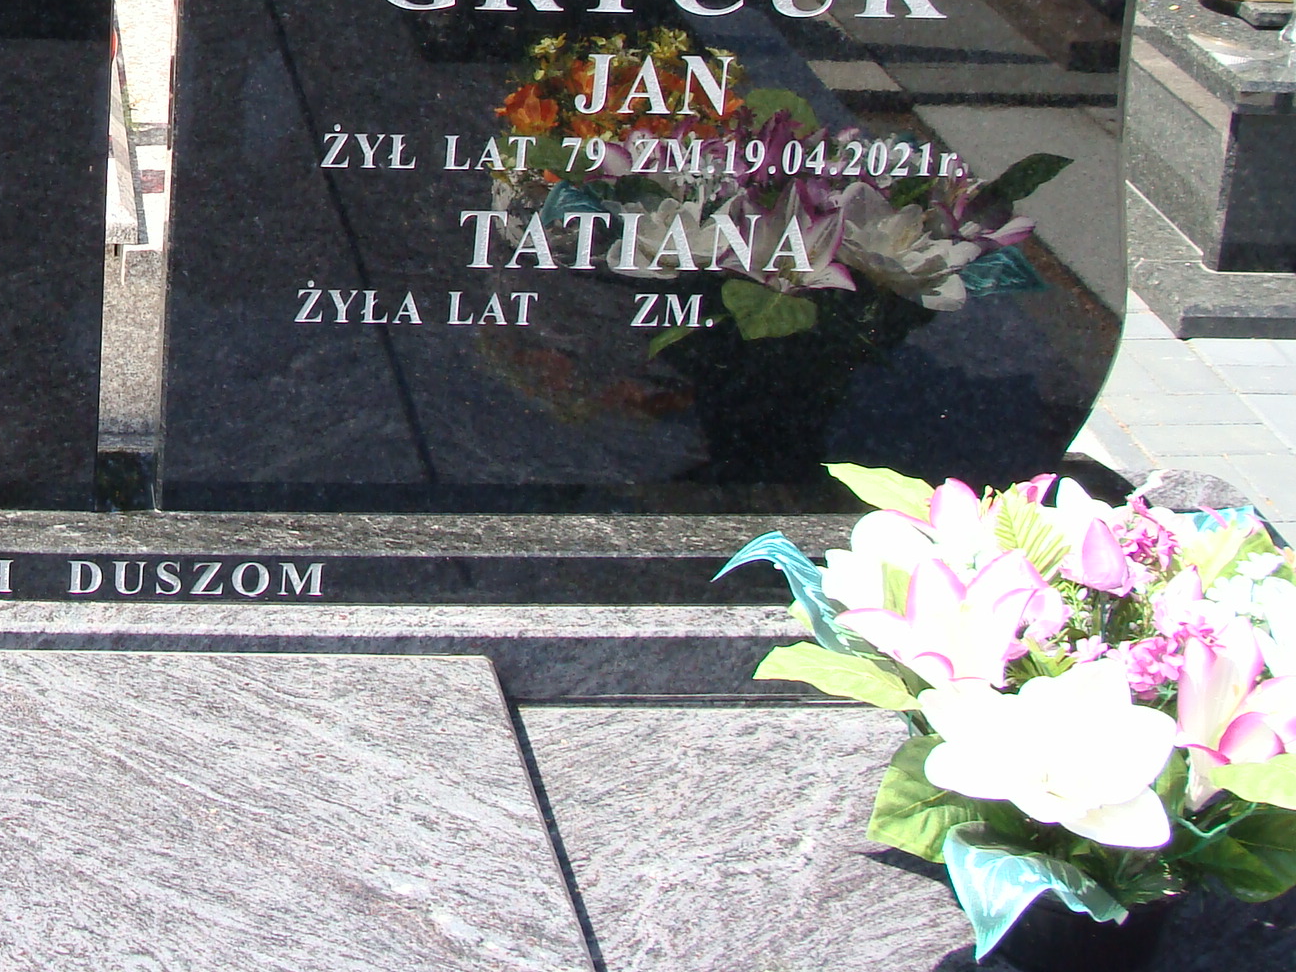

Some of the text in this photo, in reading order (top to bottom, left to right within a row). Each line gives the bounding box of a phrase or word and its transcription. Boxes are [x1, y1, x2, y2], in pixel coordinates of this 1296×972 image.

[575, 54, 734, 116] JAN
[321, 124, 417, 169] ŻYŁ
[443, 135, 536, 172] LAT
[562, 137, 606, 173] 79
[460, 210, 815, 272] TATIANA
[295, 280, 714, 328] ŻYŁA LAT ZM.
[68, 560, 325, 596] DUSZOM
